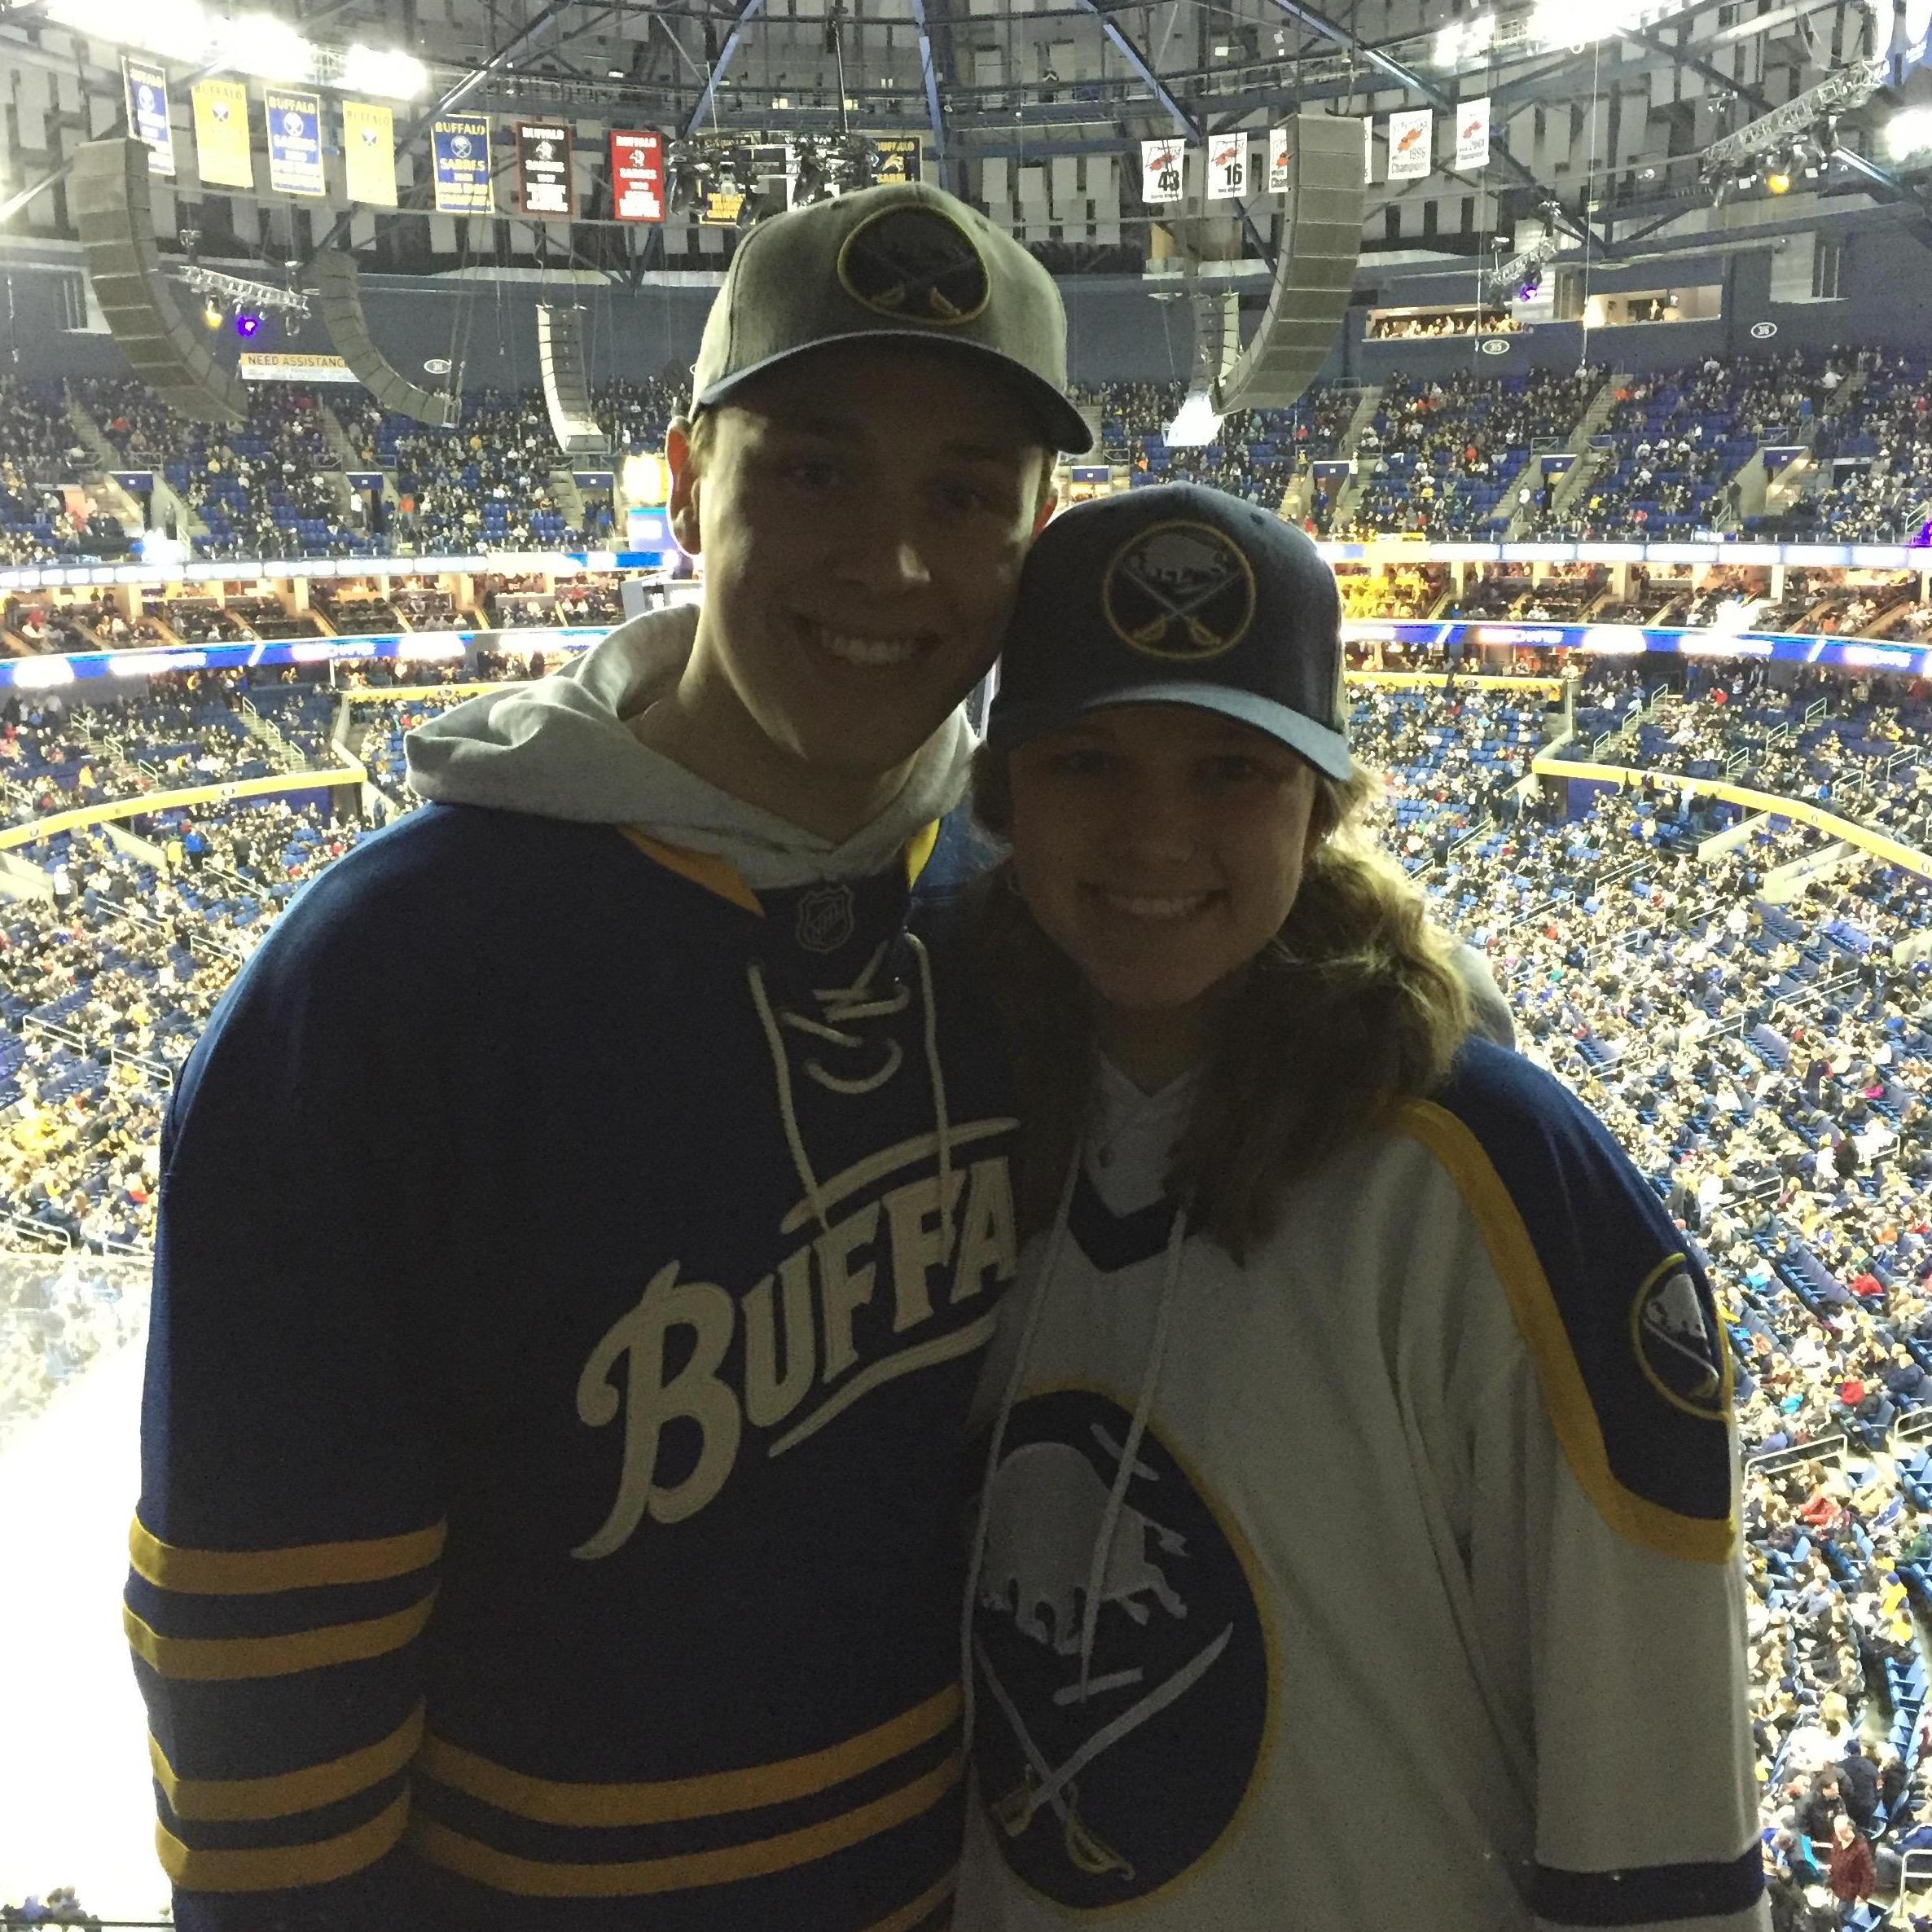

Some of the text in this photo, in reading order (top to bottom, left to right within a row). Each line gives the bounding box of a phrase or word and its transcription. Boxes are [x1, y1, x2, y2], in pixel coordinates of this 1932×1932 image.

[268, 95, 316, 115] BUFFALO
[346, 110, 390, 125] BUFFALO
[435, 121, 485, 136] BUFFALO
[521, 126, 564, 141] BUFFALO
[439, 157, 486, 172] SABRES
[1224, 163, 1243, 186] 16
[248, 356, 279, 366] NEED
